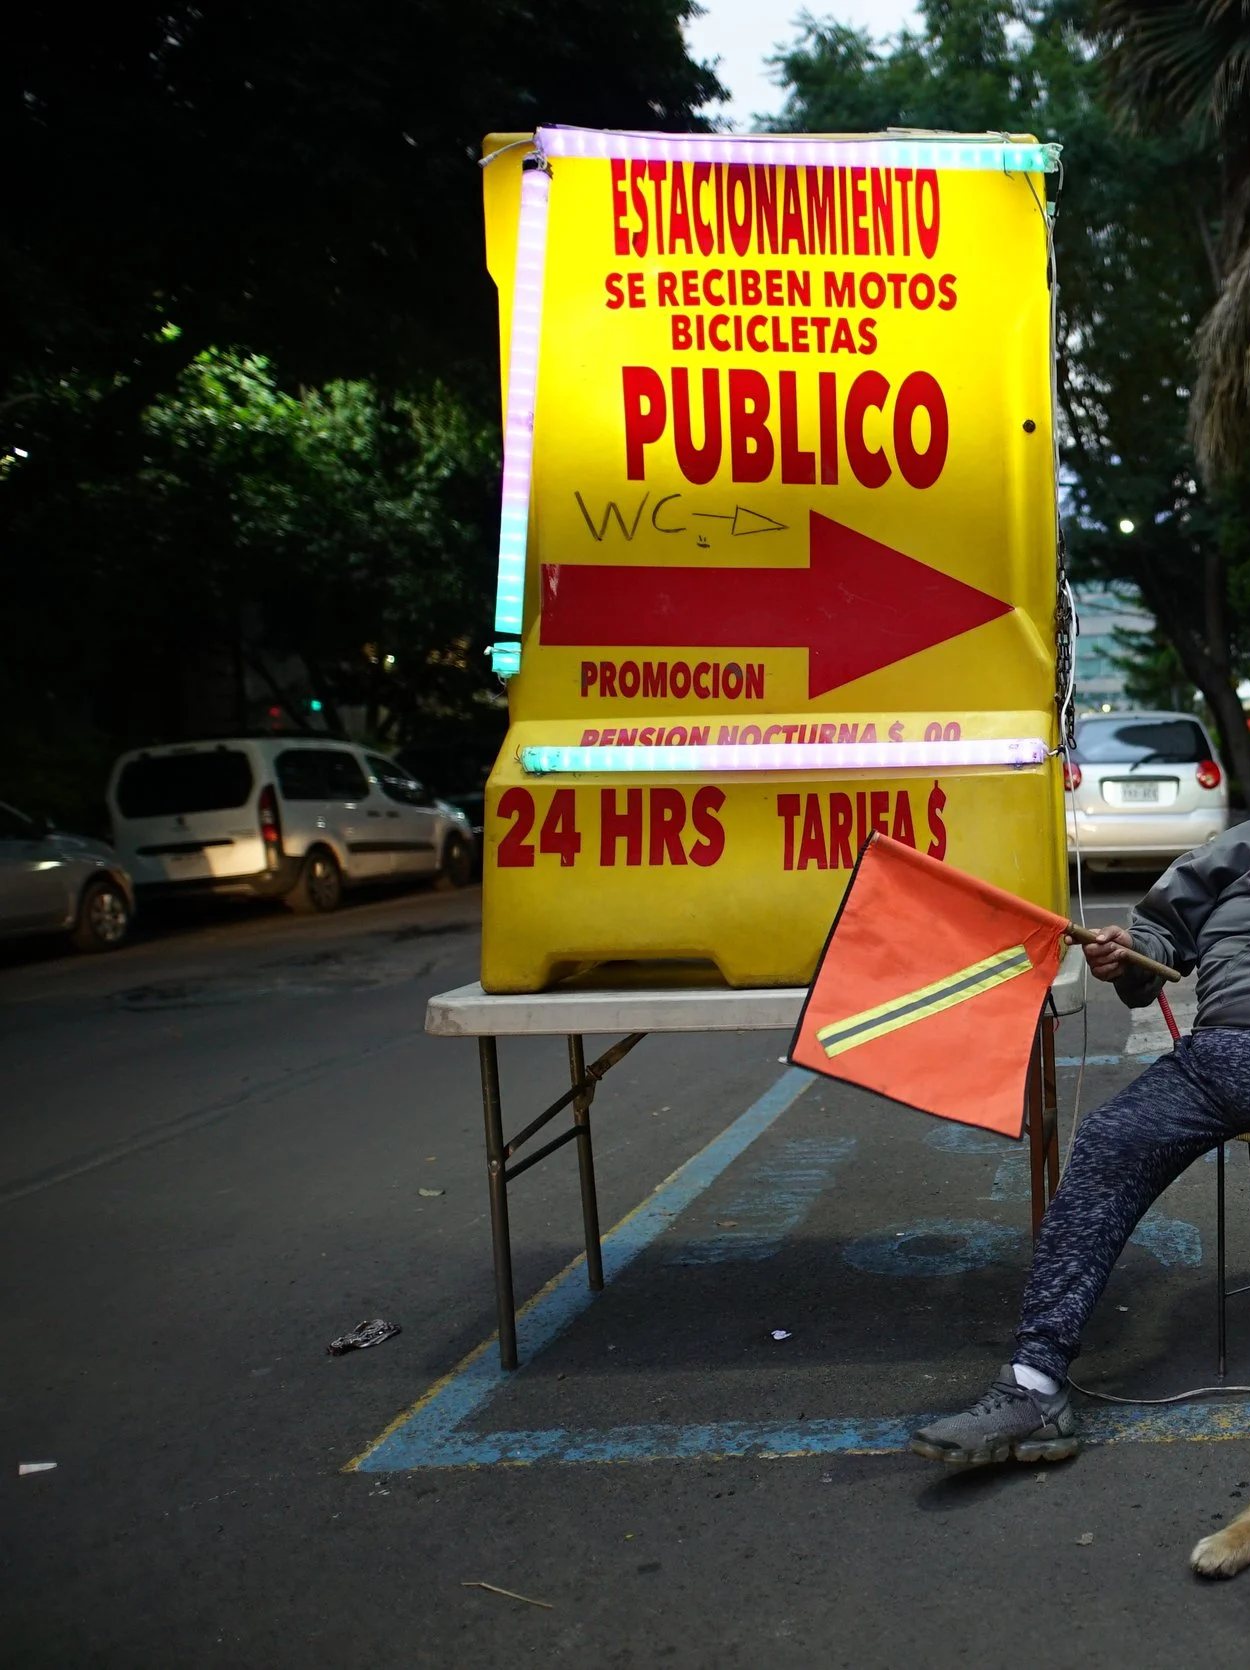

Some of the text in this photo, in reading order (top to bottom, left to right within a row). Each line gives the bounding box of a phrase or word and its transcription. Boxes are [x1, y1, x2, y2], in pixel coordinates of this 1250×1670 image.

[610, 157, 941, 260] ESTACIONAMIENTO
[605, 268, 958, 311] SE RECIBEN MOTOS
[672, 314, 877, 354] BICICLETAS
[622, 366, 949, 489] PUBLICO
[574, 491, 687, 541] WC
[580, 661, 765, 699] PROMOCION
[496, 786, 581, 868] 24
[600, 785, 727, 867] HRS
